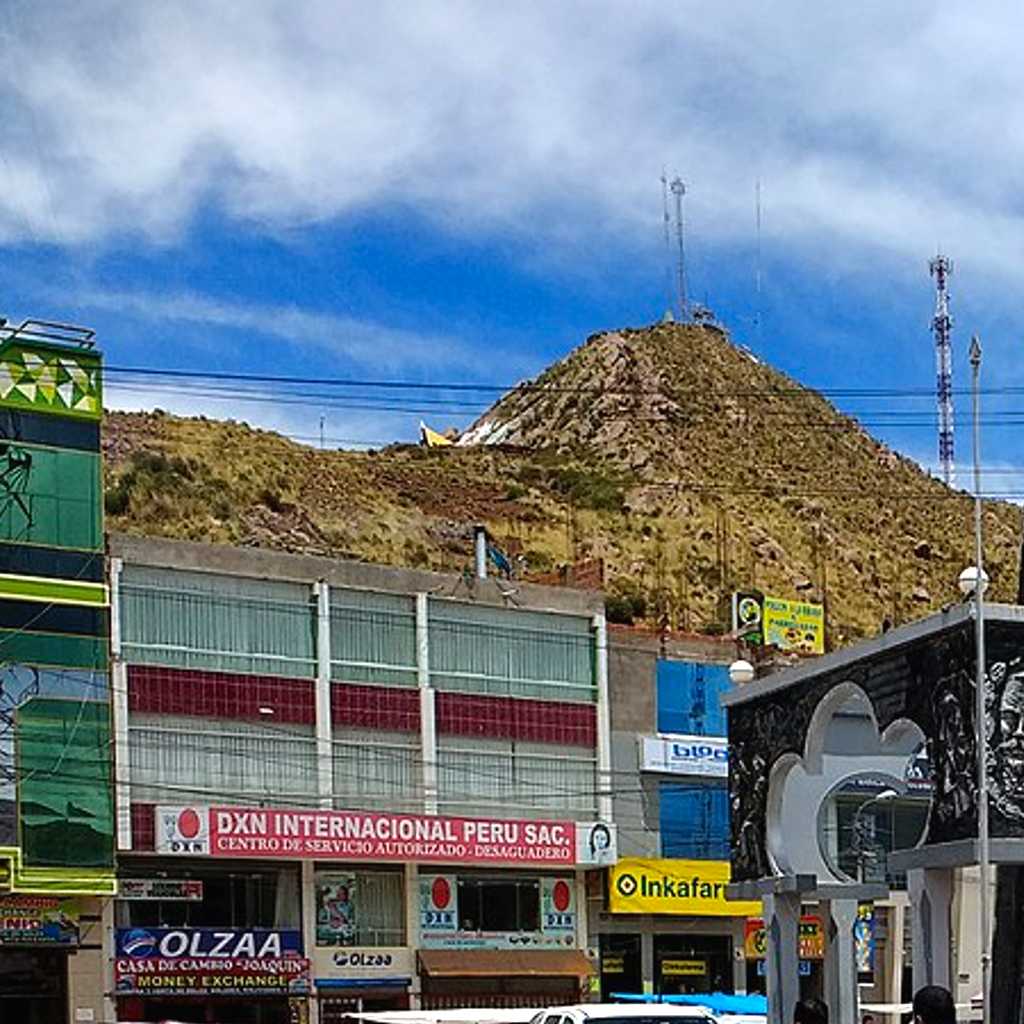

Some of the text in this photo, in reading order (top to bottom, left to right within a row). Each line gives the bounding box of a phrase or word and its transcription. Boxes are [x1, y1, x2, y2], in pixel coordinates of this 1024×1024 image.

[217, 812, 570, 845] DXN INTERNACIONAL PERU SAC.
[217, 836, 280, 850] CENTRO
[283, 838, 302, 851] DE
[305, 839, 373, 854] SERVICIO
[376, 841, 466, 857] AUTORIZADO
[475, 846, 570, 860] DESAGUADERO
[641, 874, 728, 898] Inkafar
[159, 931, 282, 958] OLZAA
[117, 960, 155, 973] CASA
[179, 959, 233, 972] CAMBIO
[350, 953, 392, 966] Olzaa
[138, 976, 288, 988] MONEY EXCHANGE
